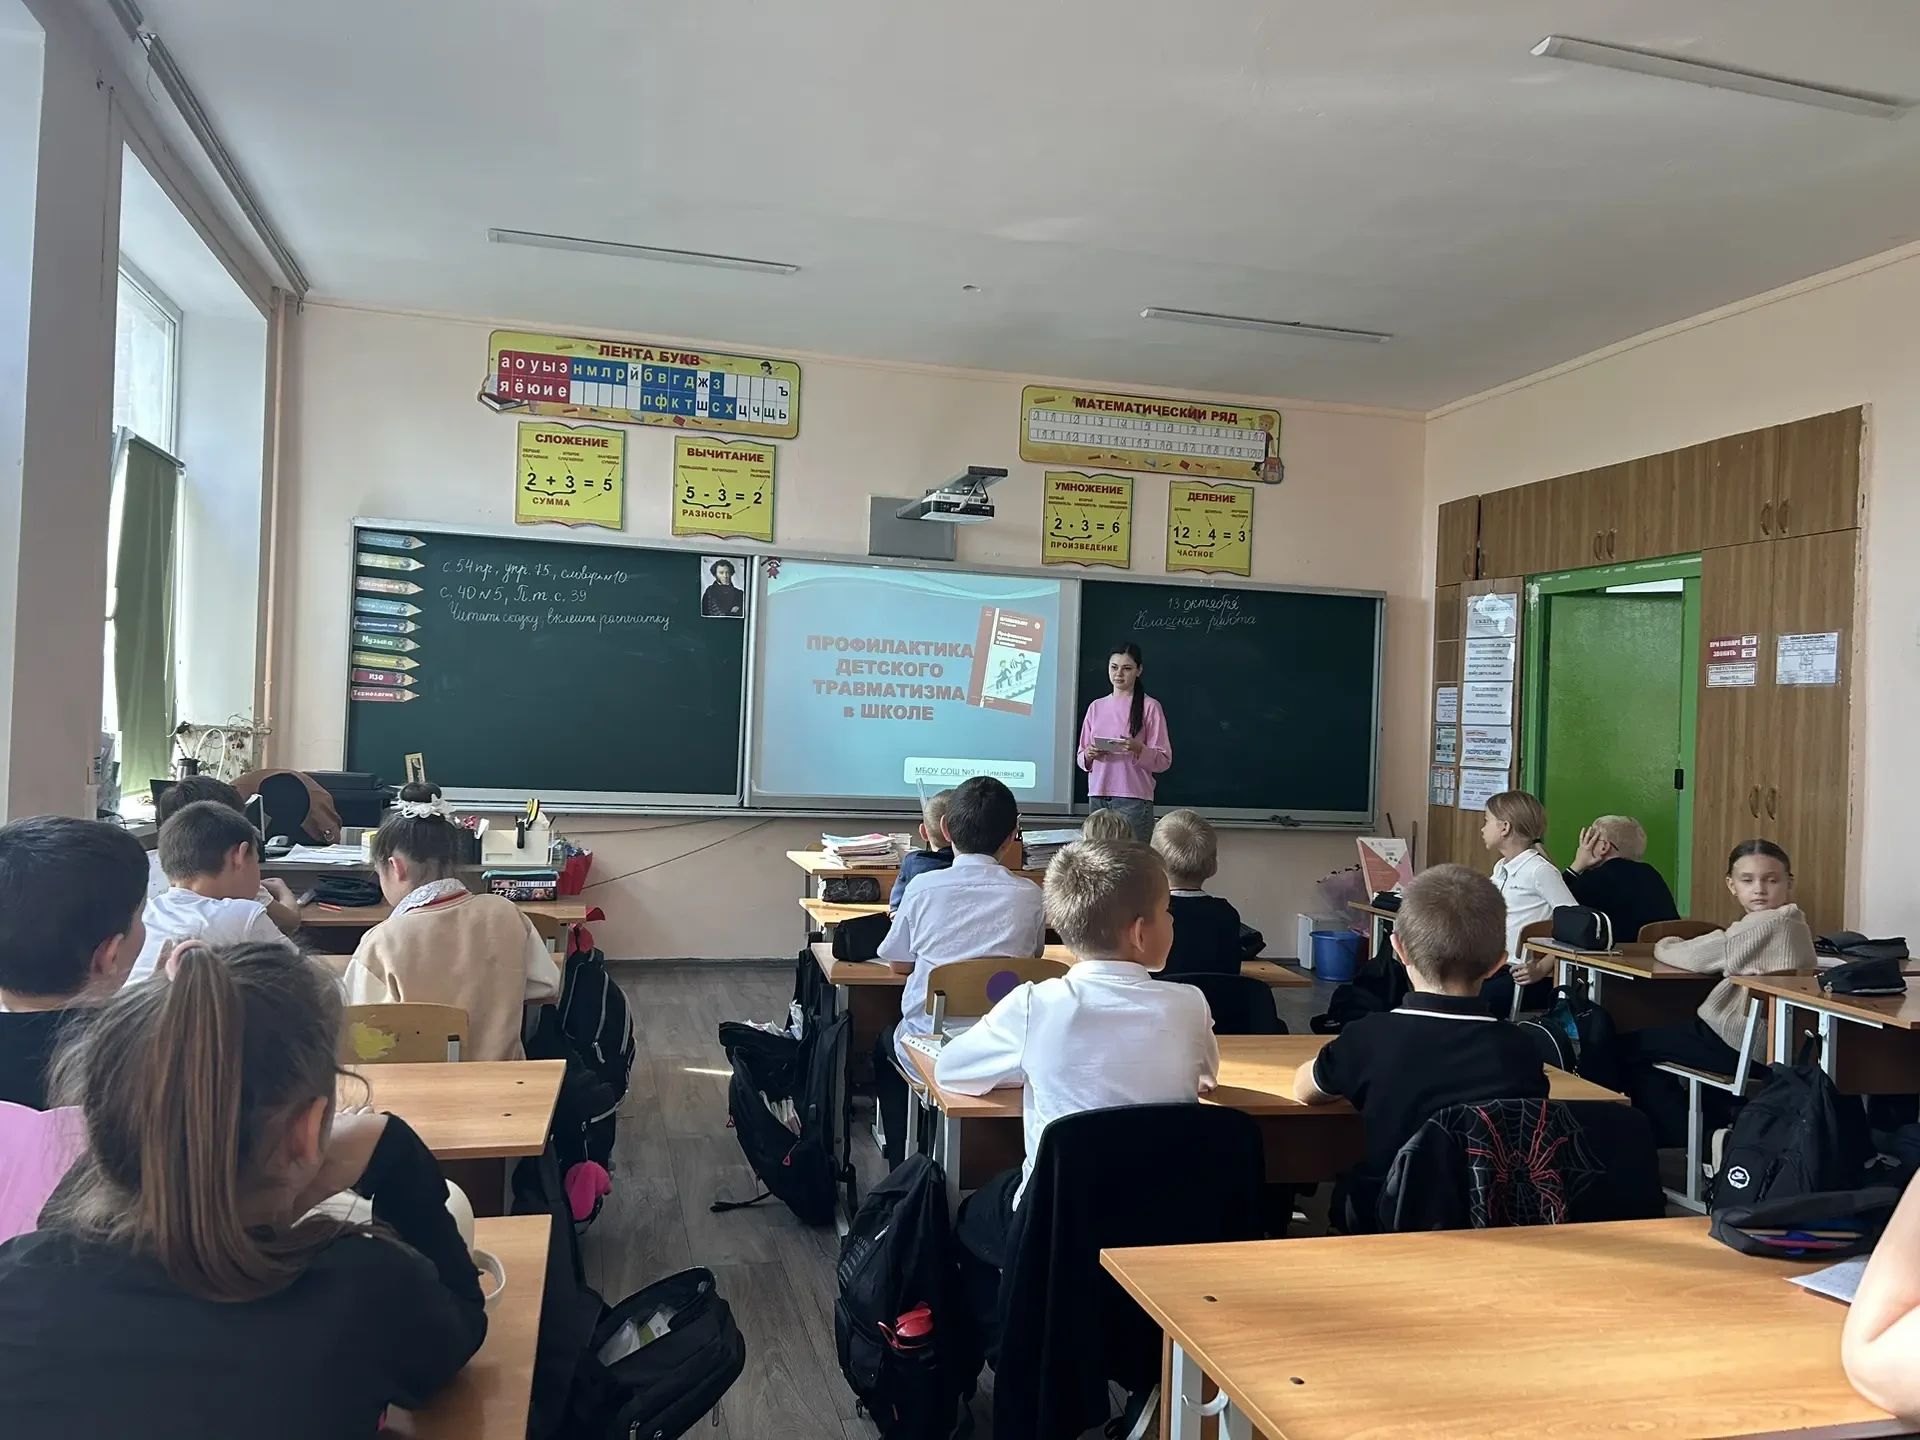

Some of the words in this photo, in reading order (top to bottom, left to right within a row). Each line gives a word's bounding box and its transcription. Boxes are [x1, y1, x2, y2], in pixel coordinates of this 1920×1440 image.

[599, 345, 653, 360] ЛЕНТА
[659, 351, 699, 365] БУКВ
[501, 357, 510, 368] а
[516, 359, 525, 369] о
[530, 360, 539, 373] у
[543, 361, 555, 372] ы
[559, 363, 567, 373] э
[574, 364, 582, 375] н
[587, 366, 597, 376] м
[601, 367, 610, 377] л
[616, 368, 625, 381] р
[630, 367, 639, 381] й
[644, 368, 652, 381] б
[658, 374, 666, 383] в
[673, 375, 679, 384] г
[684, 376, 695, 388] д
[698, 377, 709, 388] ж
[713, 379, 720, 389] з
[779, 387, 788, 396] ъ
[500, 381, 509, 391] я
[515, 379, 523, 393] ё
[527, 384, 540, 394] ю
[544, 385, 552, 396] и
[558, 387, 567, 397] е
[643, 395, 651, 405] п
[655, 393, 667, 410] ф
[672, 398, 679, 408] к
[684, 399, 693, 409] т
[697, 401, 708, 411] ш
[712, 402, 720, 412] с
[726, 404, 733, 414] х
[739, 405, 747, 417] ц
[753, 407, 760, 416] ч
[764, 408, 776, 419] щ
[779, 409, 787, 419] ь
[1075, 398, 1206, 420] МАТЕМАТИЧЕСКИЙ
[1211, 411, 1238, 424] РЯД
[535, 434, 609, 448] СЛОЖЕНИЕ
[687, 448, 764, 463] ВЫЧИТАНИЕ
[527, 473, 536, 485] 2
[565, 476, 574, 488] 3
[603, 479, 612, 491] 5
[1055, 482, 1123, 494] УМНОЖЕНИЕ
[532, 497, 570, 506] СУММА
[686, 486, 695, 498] 5
[718, 489, 727, 501] 3
[753, 492, 762, 504] 2
[1188, 492, 1236, 503] ДЕЛЕНИЕ
[682, 509, 732, 519] РАЗНОСТЬ
[1054, 518, 1062, 529] 2
[1081, 520, 1089, 531] 3
[1112, 522, 1120, 533] 6
[1173, 526, 1190, 538] 12
[1208, 529, 1216, 540] 4
[1238, 531, 1245, 542] 3
[1051, 541, 1118, 551] ПРОИЗВЕДЕНИЕ
[571, 590, 587, 601] 39
[1168, 598, 1180, 609] 13
[362, 635, 393, 645] Музыка
[807, 635, 975, 658] ПРОФИЛАКТИКА
[836, 659, 943, 678] ДЕТСКОГО
[353, 689, 393, 697] Технология
[812, 679, 965, 700] ТРАВМАТИЗМА
[861, 704, 934, 720] ШКОЛЕ
[962, 768, 975, 776] №3
